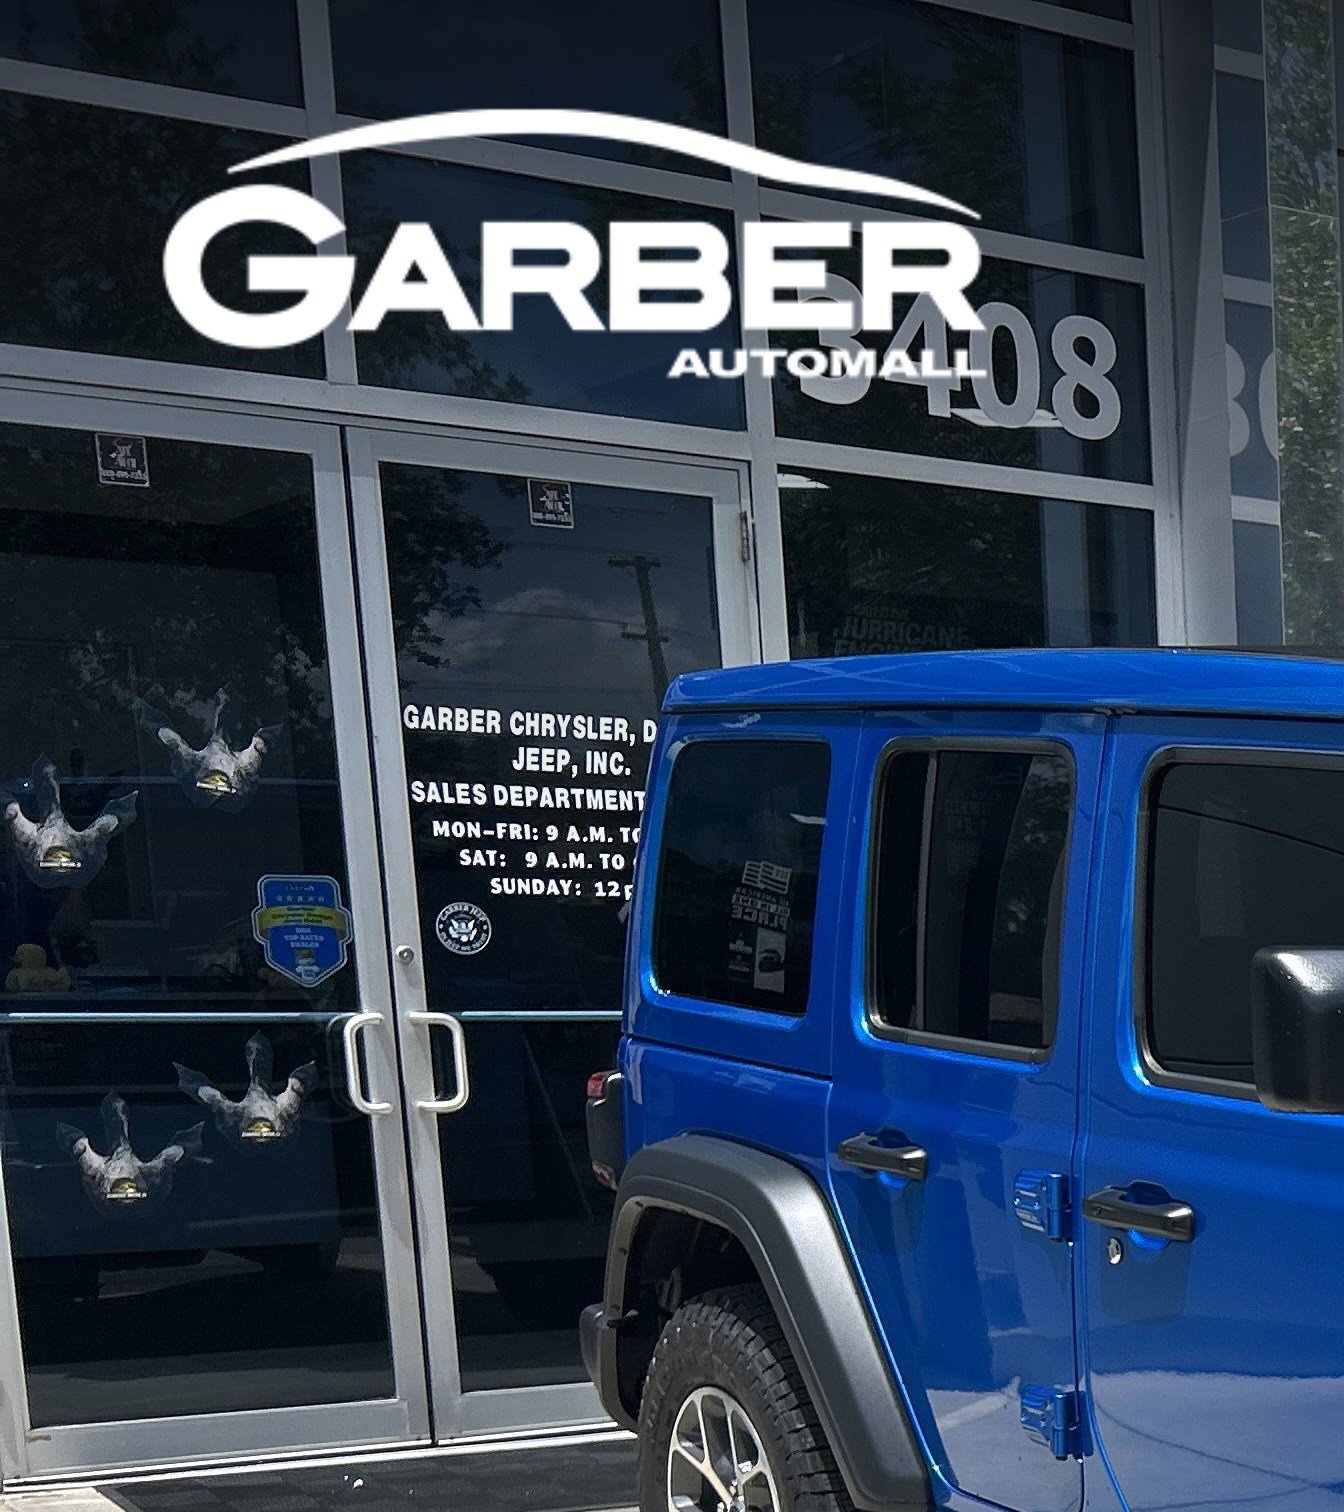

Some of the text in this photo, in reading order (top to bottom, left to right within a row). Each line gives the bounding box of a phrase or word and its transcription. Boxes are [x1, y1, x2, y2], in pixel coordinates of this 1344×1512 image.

[402, 704, 502, 734] GARBER
[509, 710, 636, 747] CHRYSLER,
[511, 746, 632, 779] JEEP, INC.
[410, 780, 647, 812] SALES DEPARTMENT
[432, 820, 539, 842] MON-FRI:
[545, 824, 559, 842] 9
[566, 825, 613, 843] A.M.
[459, 848, 507, 868] SAT:
[525, 851, 538, 869] 9
[546, 852, 593, 870] A.M.
[599, 853, 625, 871] TO
[490, 877, 582, 897] SUNDAY:
